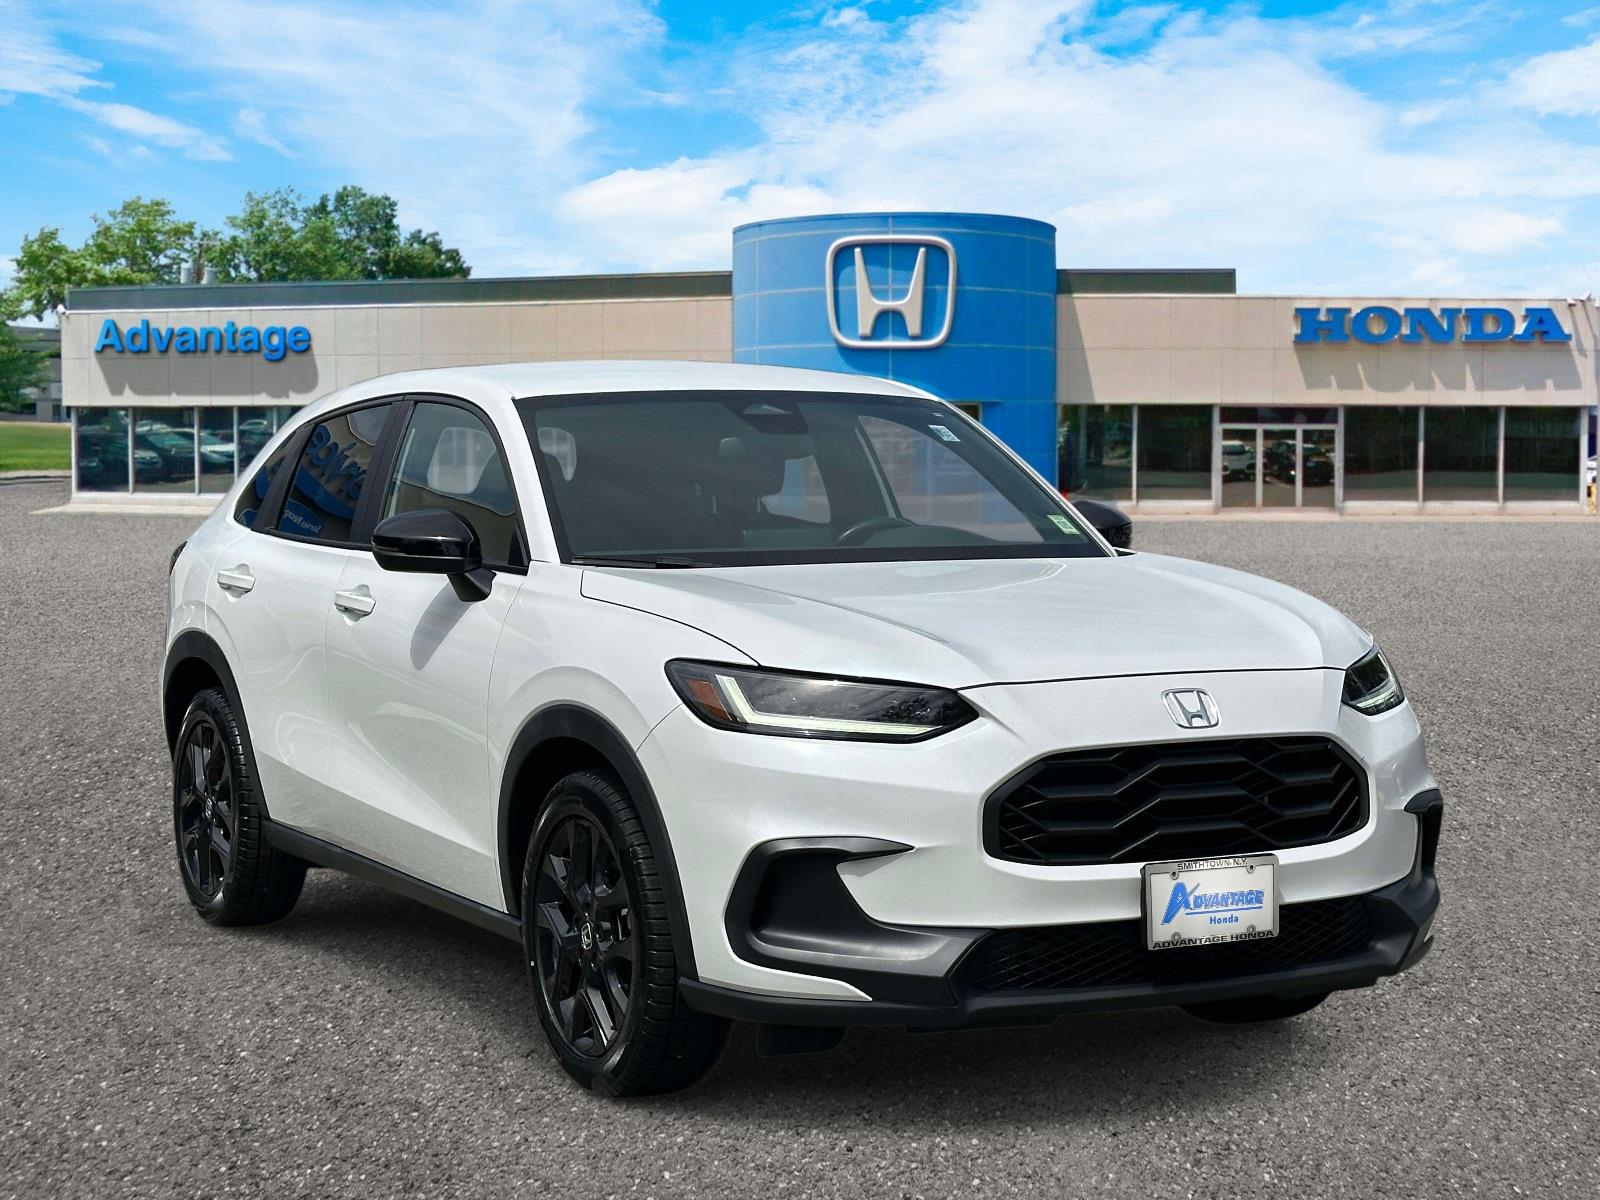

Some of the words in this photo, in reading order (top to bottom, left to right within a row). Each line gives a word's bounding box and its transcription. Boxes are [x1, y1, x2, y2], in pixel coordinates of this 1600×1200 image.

[95, 318, 311, 361] Advantage
[1294, 306, 1572, 343] HONDA
[1161, 882, 1264, 925] ADVANTAGE
[1209, 914, 1239, 925] Honda
[1152, 935, 1228, 949] ADVANTAGE
[1230, 930, 1275, 941] HONDA
